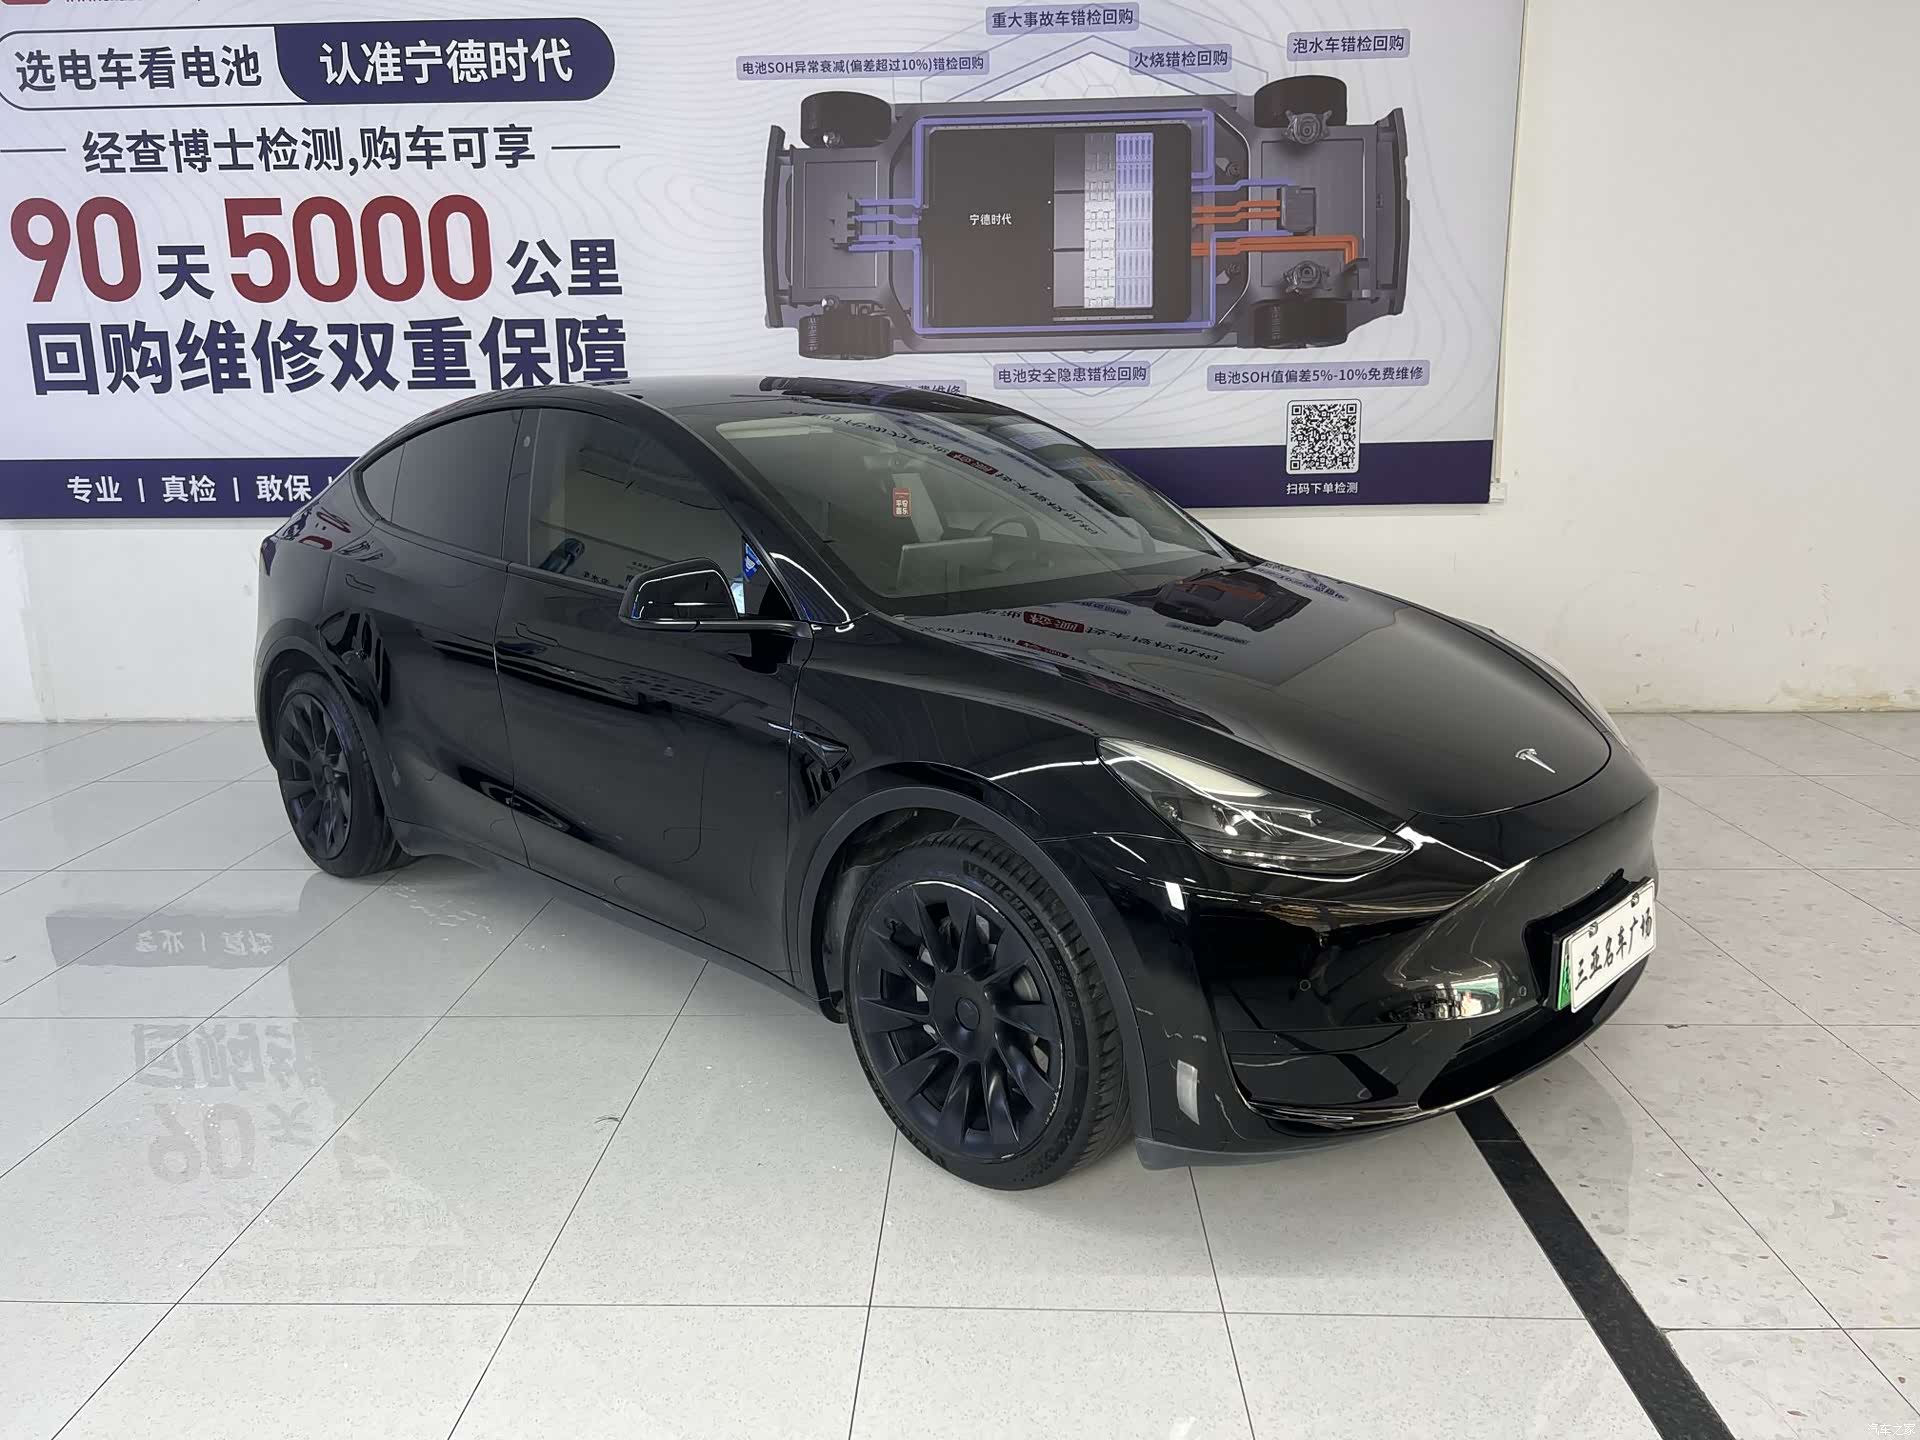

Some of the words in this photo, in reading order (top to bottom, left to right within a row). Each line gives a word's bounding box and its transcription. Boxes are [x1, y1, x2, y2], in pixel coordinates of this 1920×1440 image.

[991, 9, 1134, 29] 重大事故车错检回购
[1292, 35, 1405, 54] 泡水车错检回购
[15, 45, 262, 92] 选电车看电池
[319, 39, 573, 86] 认准宁德时代
[742, 56, 984, 75] 电池SOH异常衰减(偏差超过10%)错检回购
[1133, 50, 1229, 68] 火烧错检回购
[83, 124, 535, 176] 经查博士检测,购车可享
[969, 213, 1012, 226] 宁德时代
[10, 196, 143, 303] 90
[157, 244, 215, 300] 天
[223, 194, 493, 302] 5000
[506, 237, 624, 298] 公里
[26, 315, 630, 396] 回购维修双重保障
[998, 366, 1148, 384] 电池安全隐患错检回购
[1214, 367, 1424, 386] 电池SOH值偏差5%-10%免费维修
[67, 476, 122, 503] 专业
[161, 475, 216, 503] 真检
[256, 475, 312, 502] 敢保
[1286, 482, 1358, 495] 扫码下单检测
